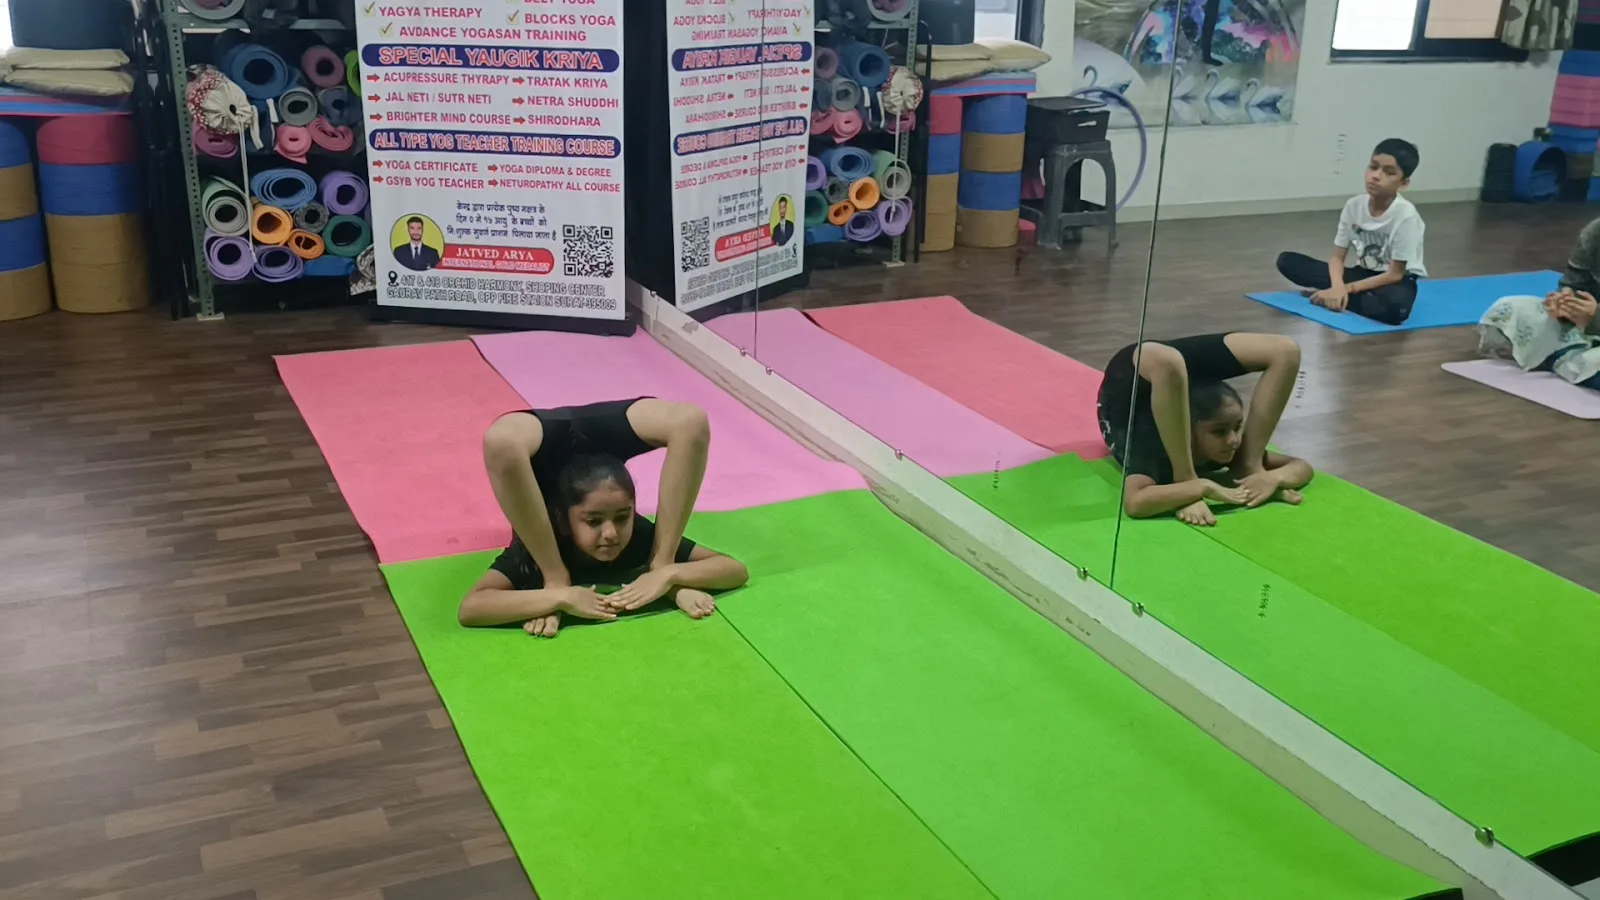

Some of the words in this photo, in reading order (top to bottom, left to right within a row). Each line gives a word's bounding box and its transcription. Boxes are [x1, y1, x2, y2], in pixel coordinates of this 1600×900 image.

[379, 6, 420, 17] YAGYA
[424, 7, 483, 18] THERAPY
[525, 13, 576, 25] BLOCKS
[579, 15, 616, 26] YOGA
[400, 26, 457, 37] AVDANCE
[461, 27, 521, 39] YOGASAN
[525, 29, 587, 41] TRAINING
[379, 47, 463, 66] SPECIAL
[465, 48, 540, 68] YAUGIK
[543, 50, 604, 70] KRIYA
[383, 72, 458, 83] ACUPRESSURE
[461, 73, 510, 85] THYRAPY
[527, 76, 570, 87] TRATAK
[574, 77, 608, 89] KRIYA
[385, 92, 404, 102] JAL
[407, 92, 430, 103] NETI
[438, 93, 465, 104] SUTR
[468, 94, 492, 105] NETI
[527, 96, 564, 107] NETRA
[568, 97, 619, 109] SHUDDHI
[386, 111, 438, 122] BRIGHTER
[441, 113, 466, 123] MIND
[469, 113, 511, 125] COURSE
[527, 114, 601, 127] SHIRODHARA
[374, 133, 399, 148] ALL
[399, 133, 427, 149] TYPE
[428, 134, 454, 149] YOG
[456, 135, 509, 151] TEACHER
[510, 136, 564, 154] TRAINING
[565, 139, 615, 156] COURSE
[385, 160, 411, 170] YOGA
[414, 161, 478, 173] CERTIFICATE
[500, 164, 524, 175] YOGA
[526, 165, 565, 176] DIPLOMA
[567, 166, 574, 176] &
[576, 166, 611, 177] DEGREE
[385, 176, 412, 187] GSYB
[414, 177, 435, 187] YOG
[438, 178, 485, 189] TEACHER
[500, 179, 563, 191] NETUROPATHY
[566, 181, 582, 191] ALL
[584, 182, 620, 193] COURSE
[456, 247, 499, 258] JATVED
[503, 250, 534, 260] ARYA
[417, 275, 424, 287] &
[442, 276, 477, 290] ORCHID
[477, 278, 524, 294] HARMONY,
[526, 280, 567, 294] SHOPING
[568, 283, 605, 297] CENTER
[386, 286, 423, 299] GAURAV
[424, 289, 447, 300] PATH
[447, 289, 477, 304] ROAD,
[478, 291, 498, 304] OPP
[498, 293, 519, 305] FIRE
